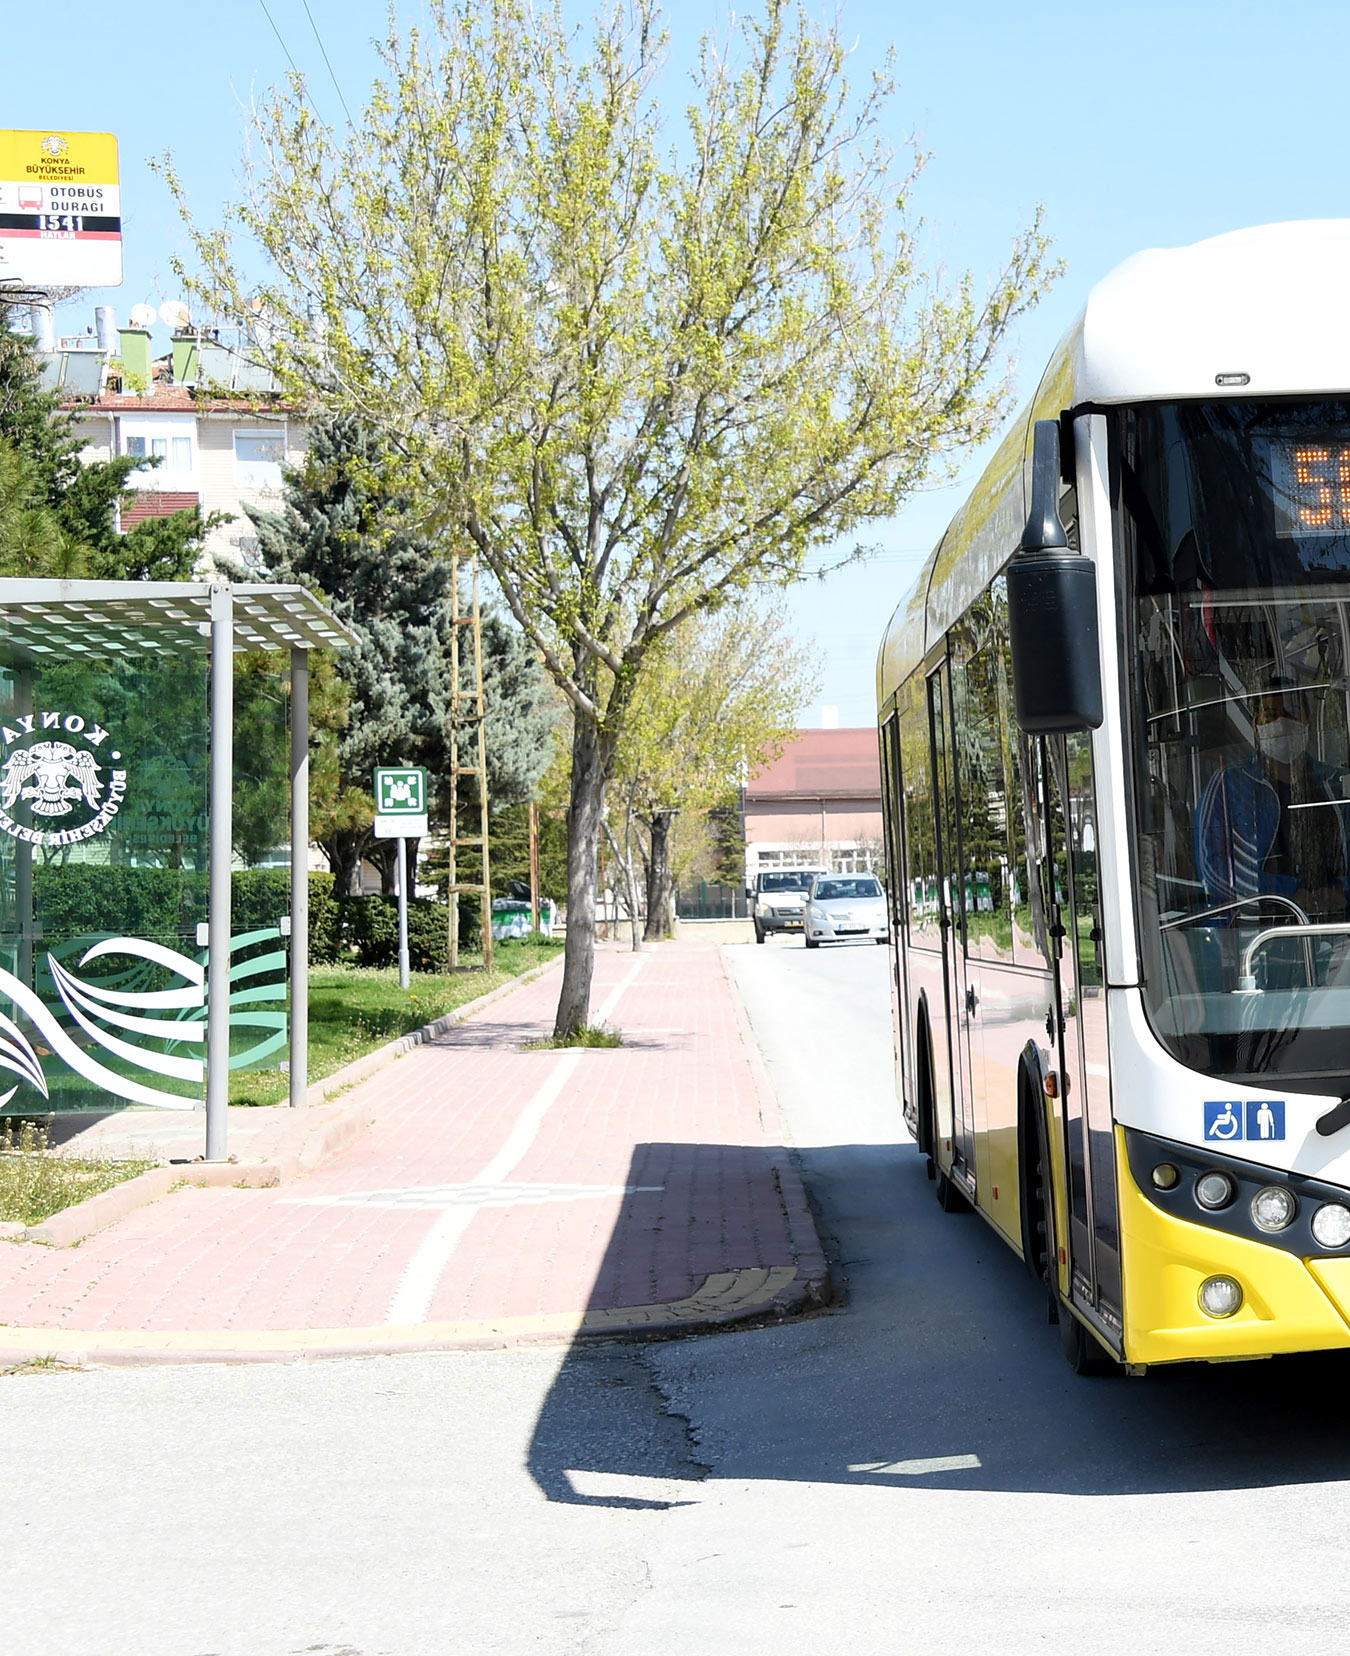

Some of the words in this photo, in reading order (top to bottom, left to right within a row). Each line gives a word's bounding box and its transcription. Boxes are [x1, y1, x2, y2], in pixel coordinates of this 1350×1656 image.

[41, 157, 70, 165] KONYA
[50, 186, 103, 198] OTOBÜS
[51, 201, 104, 212] DURAĞI
[39, 215, 83, 231] 1541
[40, 231, 76, 239] HATLAR
